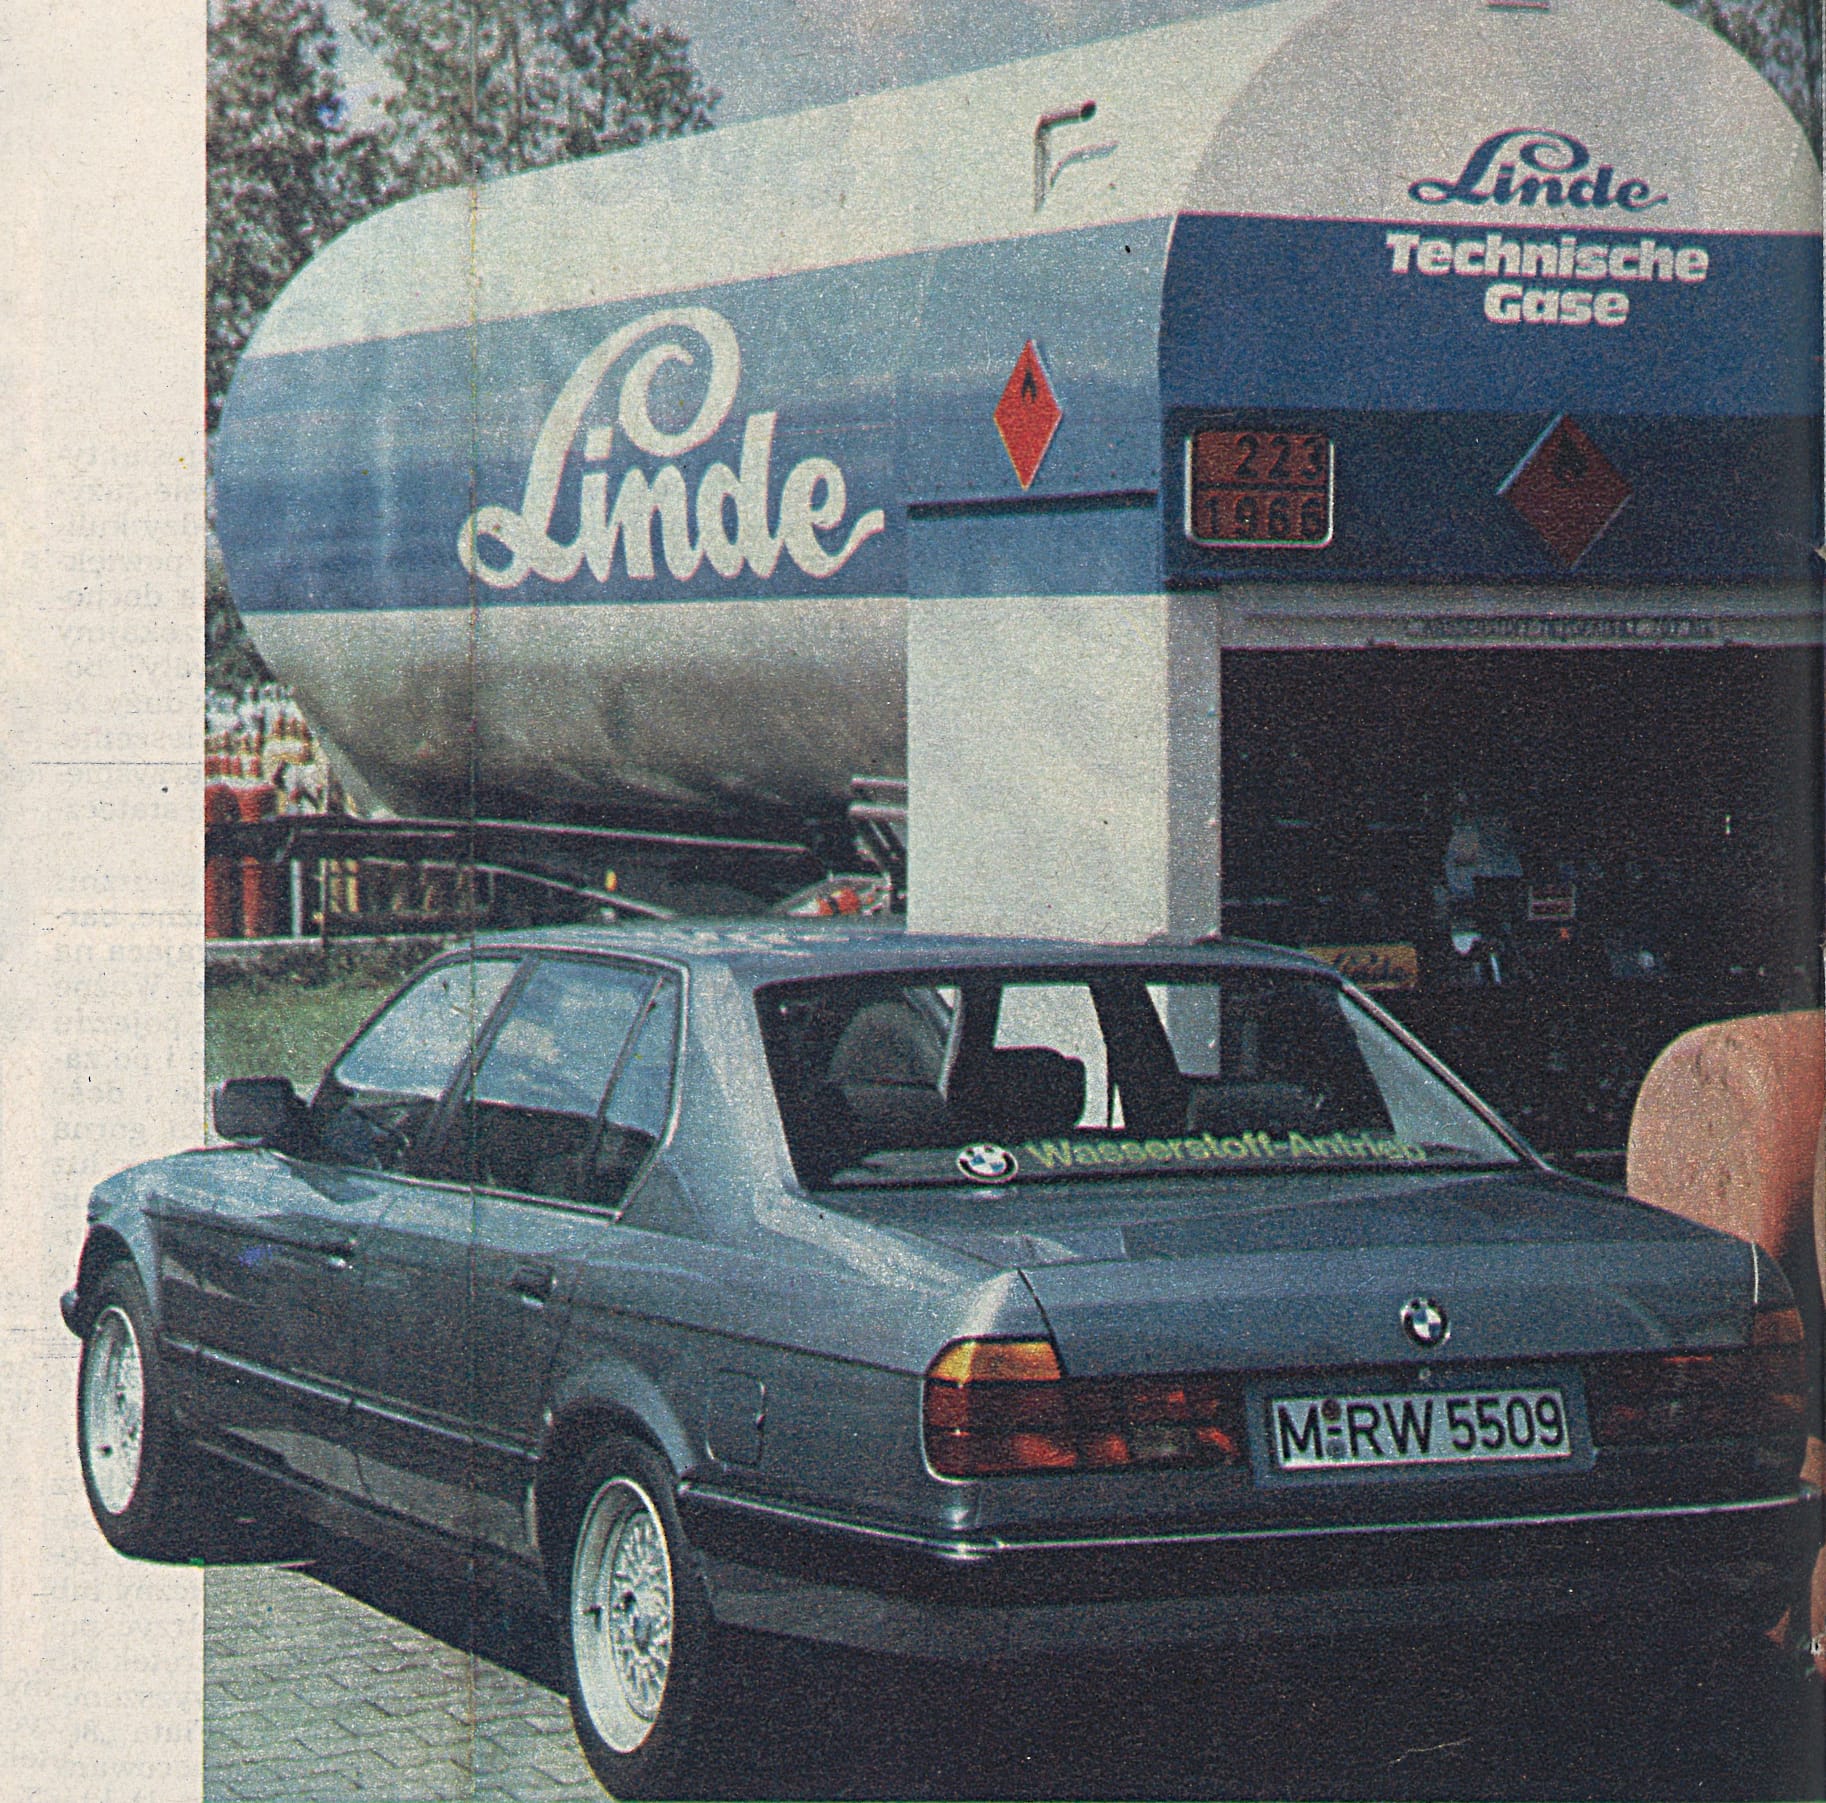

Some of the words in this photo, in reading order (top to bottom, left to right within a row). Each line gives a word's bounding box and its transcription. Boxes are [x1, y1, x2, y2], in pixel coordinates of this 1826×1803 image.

[1408, 127, 1669, 212] Linde
[1386, 231, 1710, 283] Technische
[1484, 281, 1630, 327] Gase
[457, 305, 886, 589] Linde
[1234, 434, 1324, 480] 223
[1203, 496, 1326, 538] 1966
[1023, 1129, 1427, 1169] Wasserstoff-Antrieb
[1446, 1395, 1564, 1452] 5509
